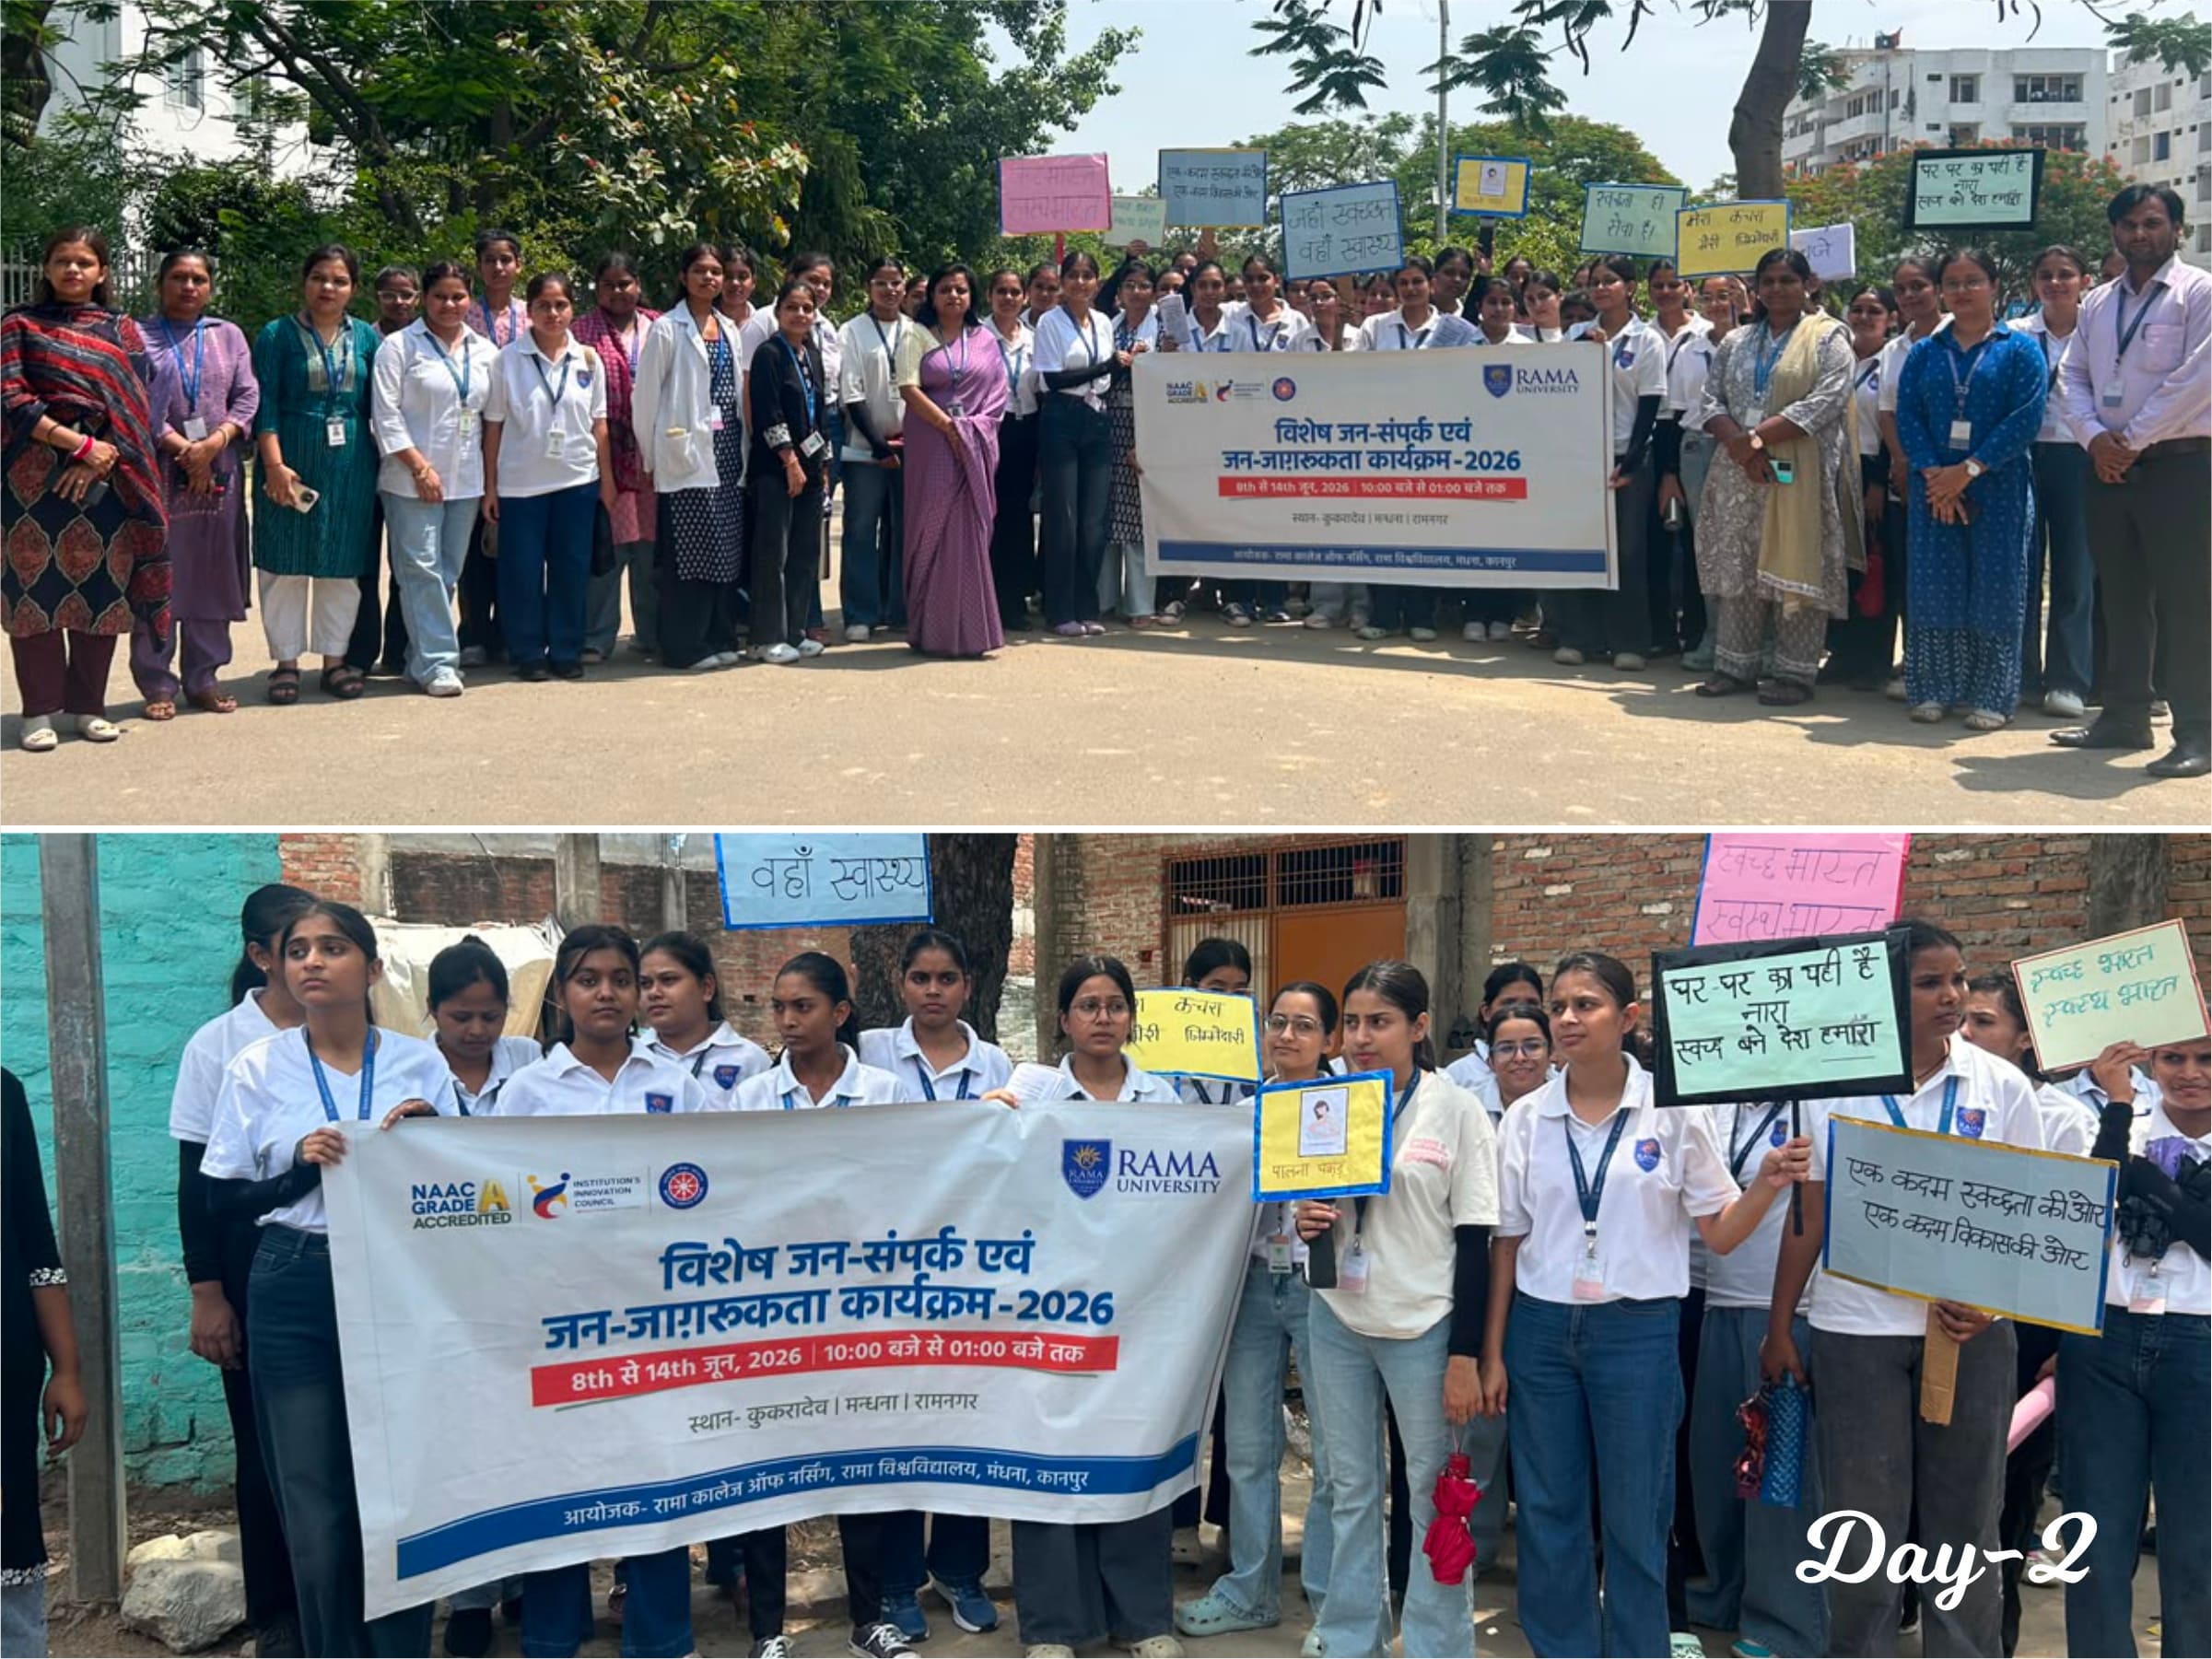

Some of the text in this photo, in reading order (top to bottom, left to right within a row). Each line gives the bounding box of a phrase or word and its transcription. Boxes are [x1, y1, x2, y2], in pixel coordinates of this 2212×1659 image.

[1516, 368, 1579, 384] RAMA
[1516, 385, 1579, 394] UNIVERSITY
[1274, 415, 1472, 444] विशेष जन-संपर्क एवं
[1258, 479, 1269, 493] से
[1270, 481, 1296, 493] 14th
[1298, 482, 1318, 496] जून,
[1322, 482, 1350, 494] 2026
[1361, 482, 1393, 494] 10:00
[1416, 478, 1426, 494] से
[1429, 482, 1461, 494] 01:00
[1485, 482, 1506, 494] तक
[751, 846, 814, 899] वहाँ
[1785, 848, 1890, 887] भारत
[1768, 966, 1794, 993] का
[1852, 946, 1880, 980] है
[2117, 975, 2180, 1006] भारत
[1741, 999, 1790, 1024] नारा
[1738, 1023, 1767, 1054] बने
[1118, 1149, 1222, 1178] RAMA
[1845, 1156, 1884, 1187] एक
[1891, 1169, 1954, 1201] कदम
[412, 1178, 510, 1214] NAAC A
[573, 1175, 641, 1187] INSTITUTION'S
[574, 1186, 631, 1197] INNOVATION
[1117, 1179, 1222, 1194] UNIVERSITY
[412, 1198, 476, 1216] GRADE
[575, 1198, 614, 1208] COUNCIL
[413, 1212, 512, 1230] ACCREDITED
[1863, 1200, 1899, 1229] एक
[1902, 1211, 1953, 1244] कदम
[2040, 1234, 2089, 1271] ओर
[659, 1225, 1036, 1291] विशेष जन-संपर्क एवं
[571, 1334, 1085, 1393] 8th से 14th जून, 2026 10:00 बजे से 01:00 बजे तक
[688, 1392, 980, 1435] स्थान- कुकरादेव मन्धना रामनगर
[563, 1455, 1090, 1527] आयोजक- रामा कालेज ऑफ नर्सिंग, रामा विश्वविद्यालय, मंधना, कानपुर
